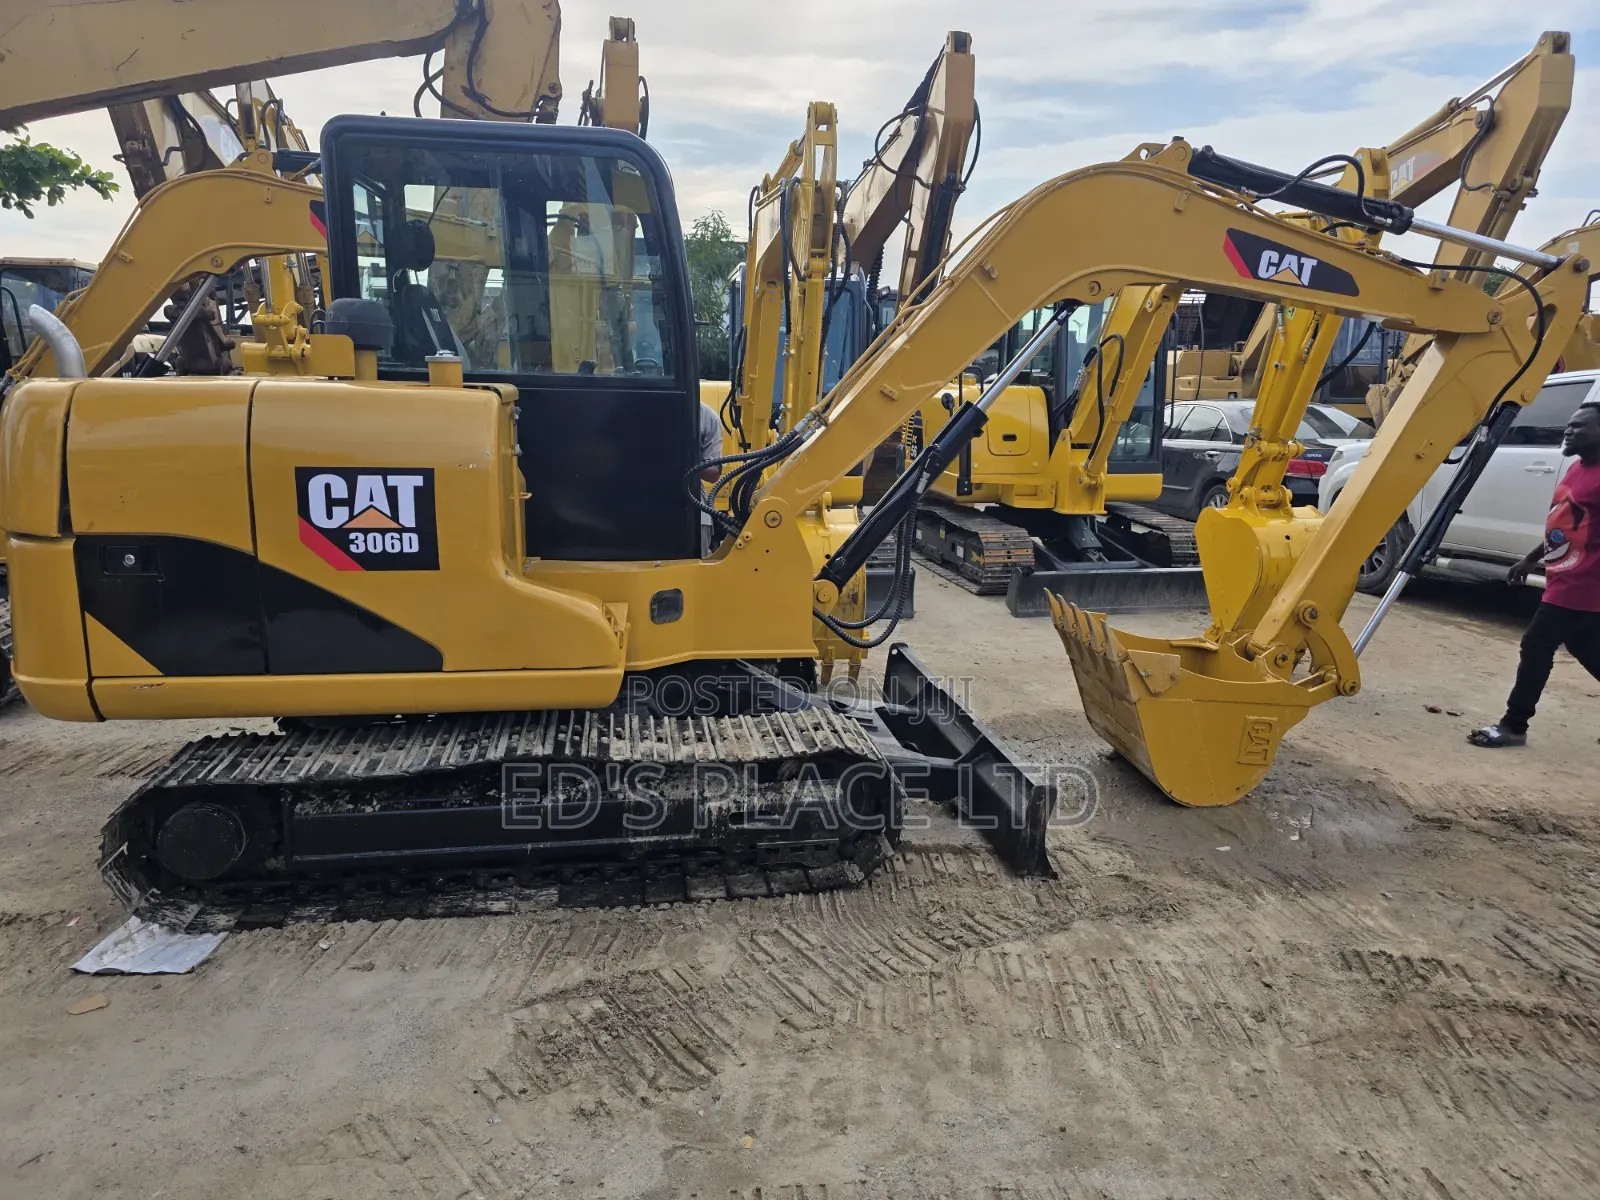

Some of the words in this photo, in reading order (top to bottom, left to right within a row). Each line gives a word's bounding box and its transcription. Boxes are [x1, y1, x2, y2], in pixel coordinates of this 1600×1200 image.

[1257, 249, 1318, 287] CAT
[308, 473, 424, 529] CAT
[348, 532, 420, 554] 306D
[1243, 721, 1273, 762] CAT
